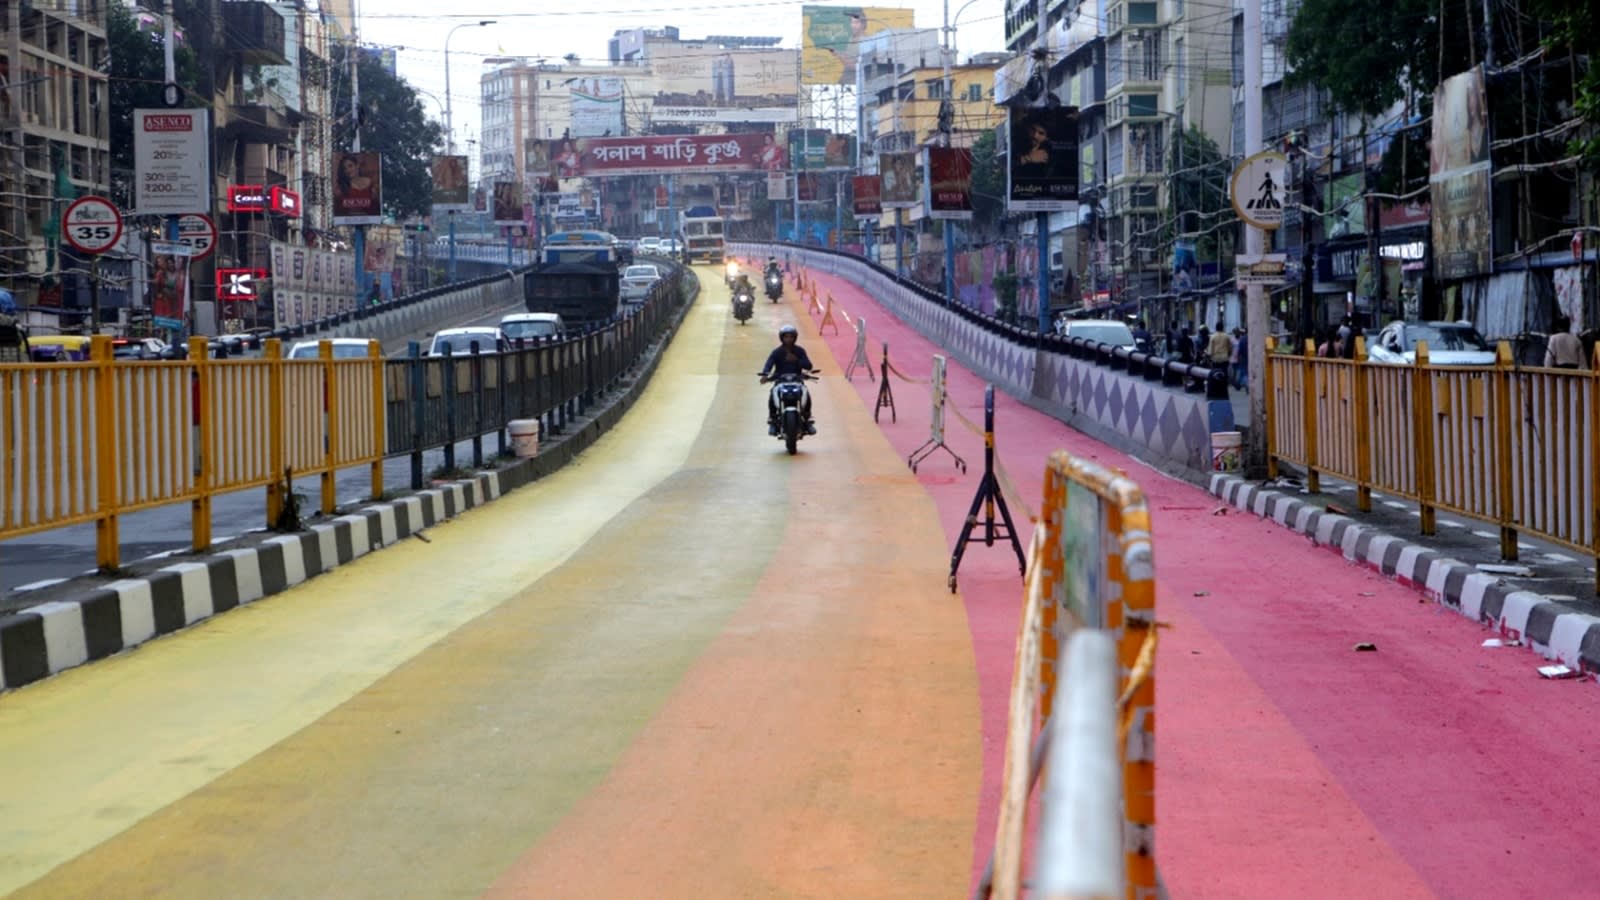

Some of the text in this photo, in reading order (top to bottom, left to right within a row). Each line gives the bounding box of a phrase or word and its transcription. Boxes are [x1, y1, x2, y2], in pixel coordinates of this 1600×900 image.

[153, 116, 190, 127] SENCO
[592, 138, 742, 163] পলাশ শাড়ি কুঞ্জ
[77, 226, 111, 240] 35
